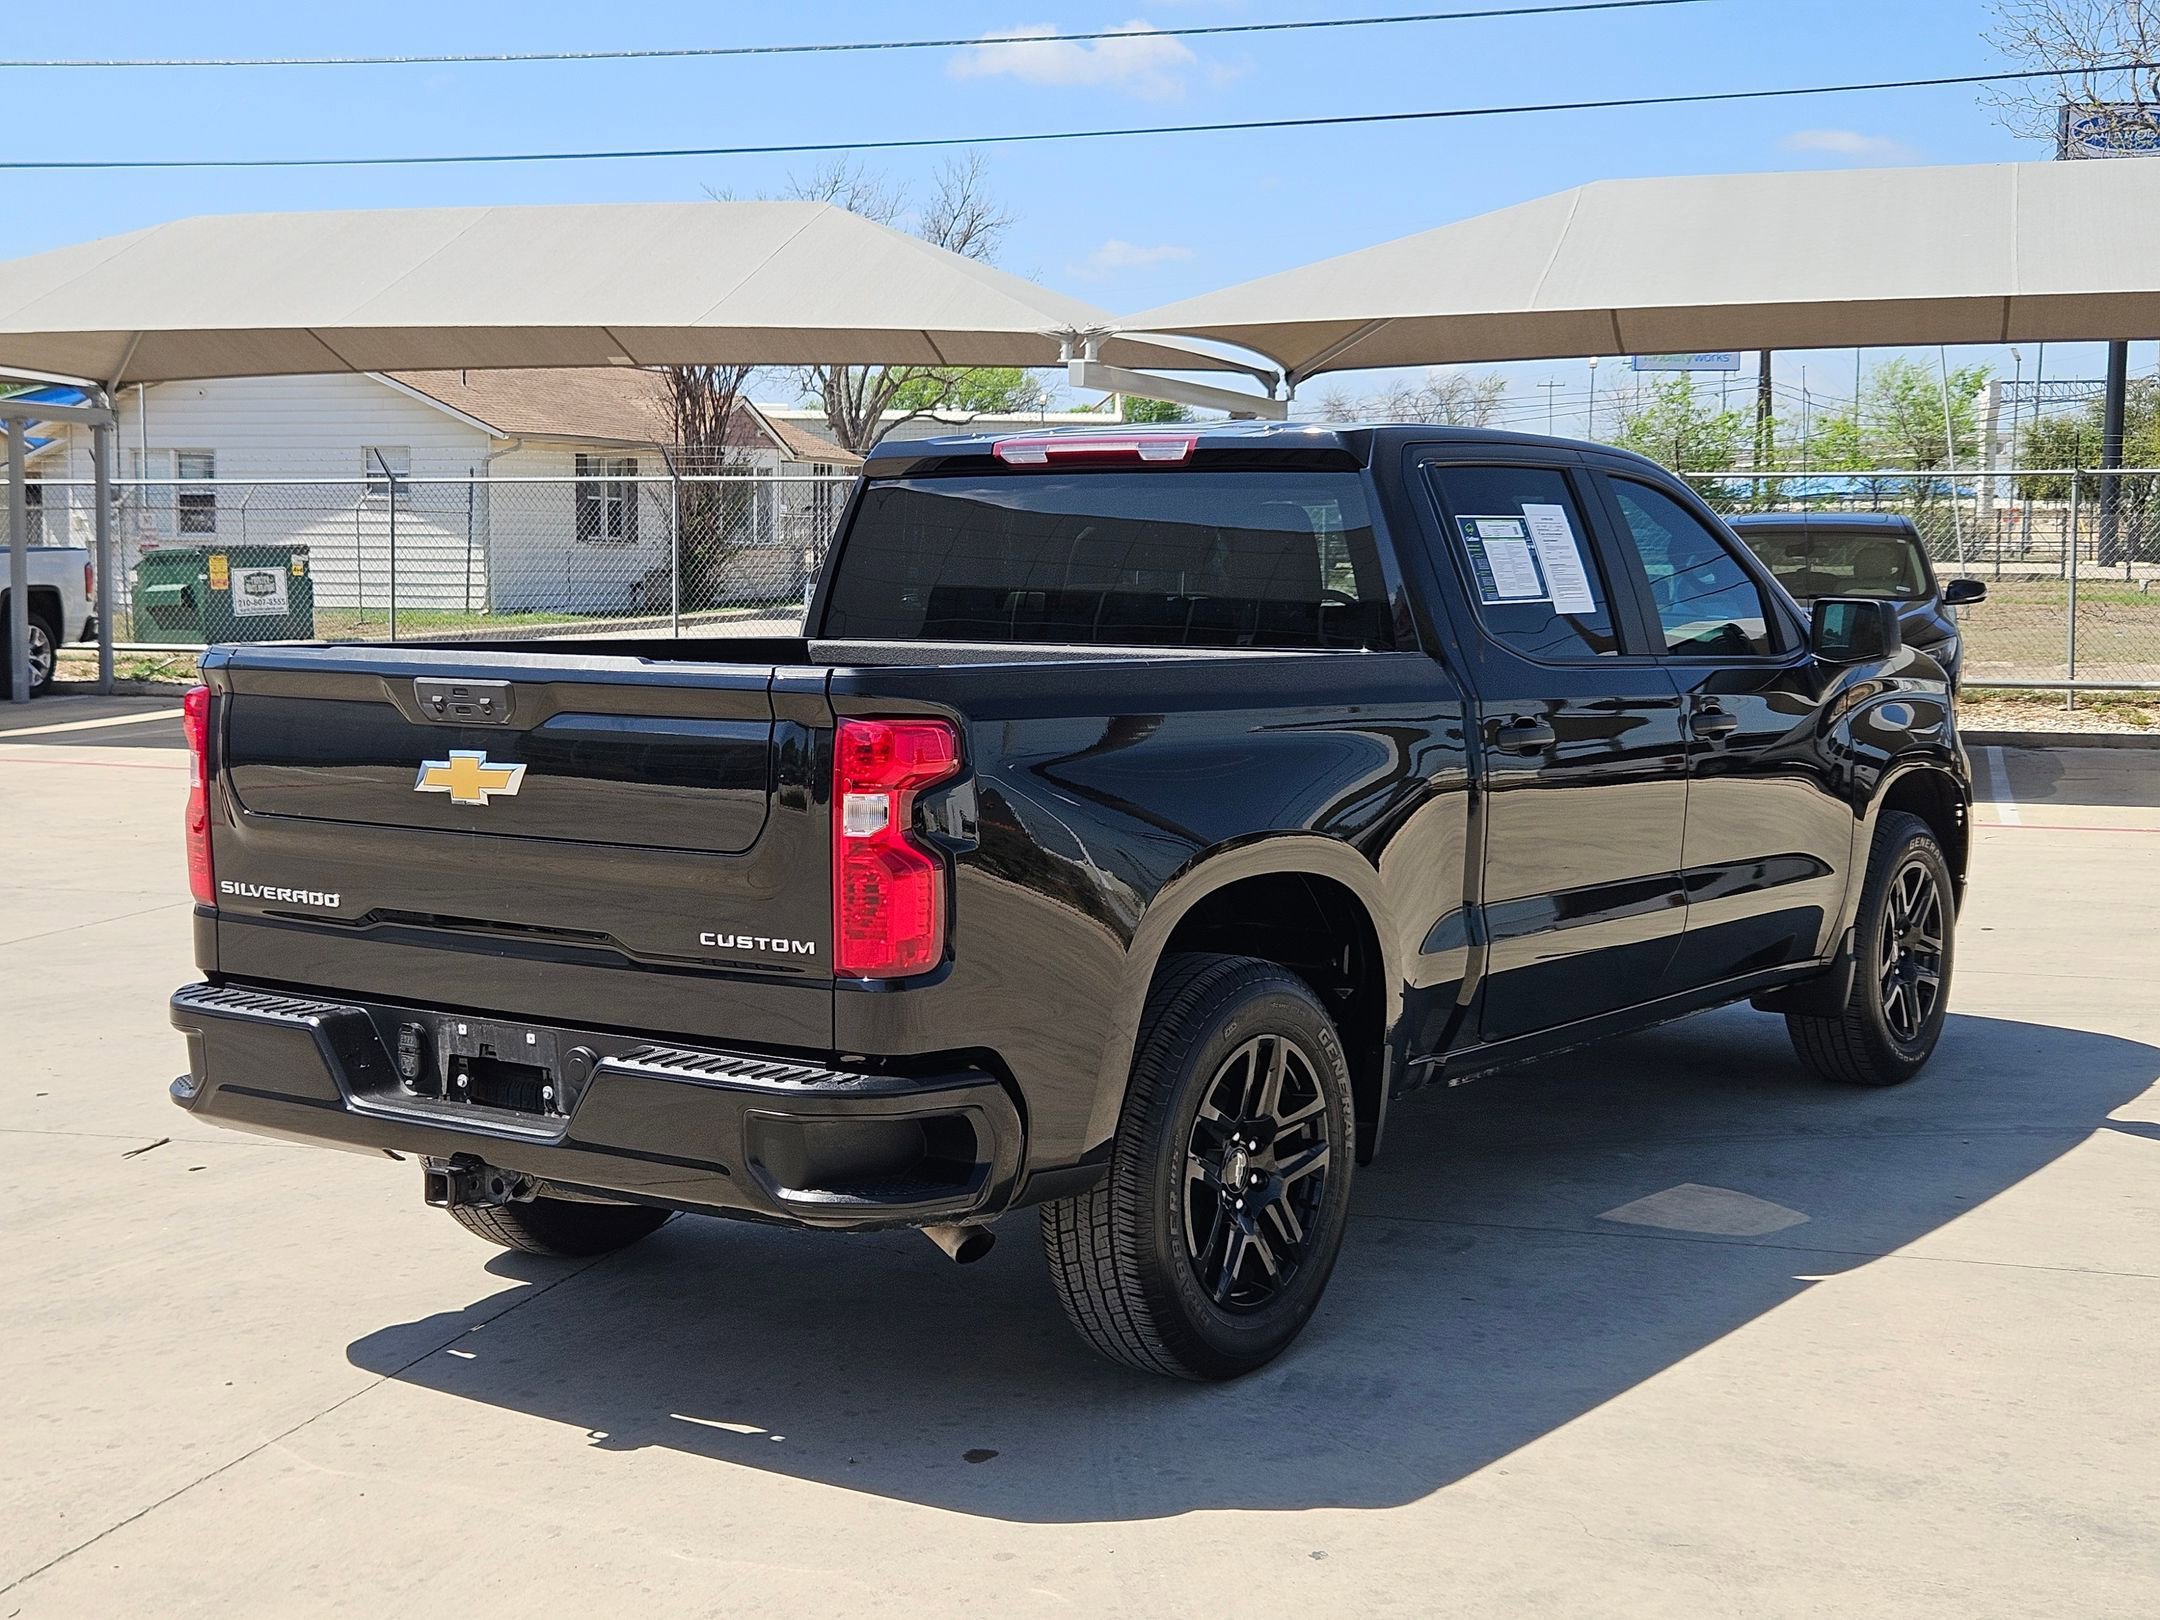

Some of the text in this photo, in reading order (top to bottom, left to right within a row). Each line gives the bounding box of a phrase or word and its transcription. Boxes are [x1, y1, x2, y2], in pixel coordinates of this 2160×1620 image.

[220, 880, 341, 908] SILVERADO
[699, 932, 816, 955] CUSTOM
[1317, 1027, 1353, 1158] GENERAL
